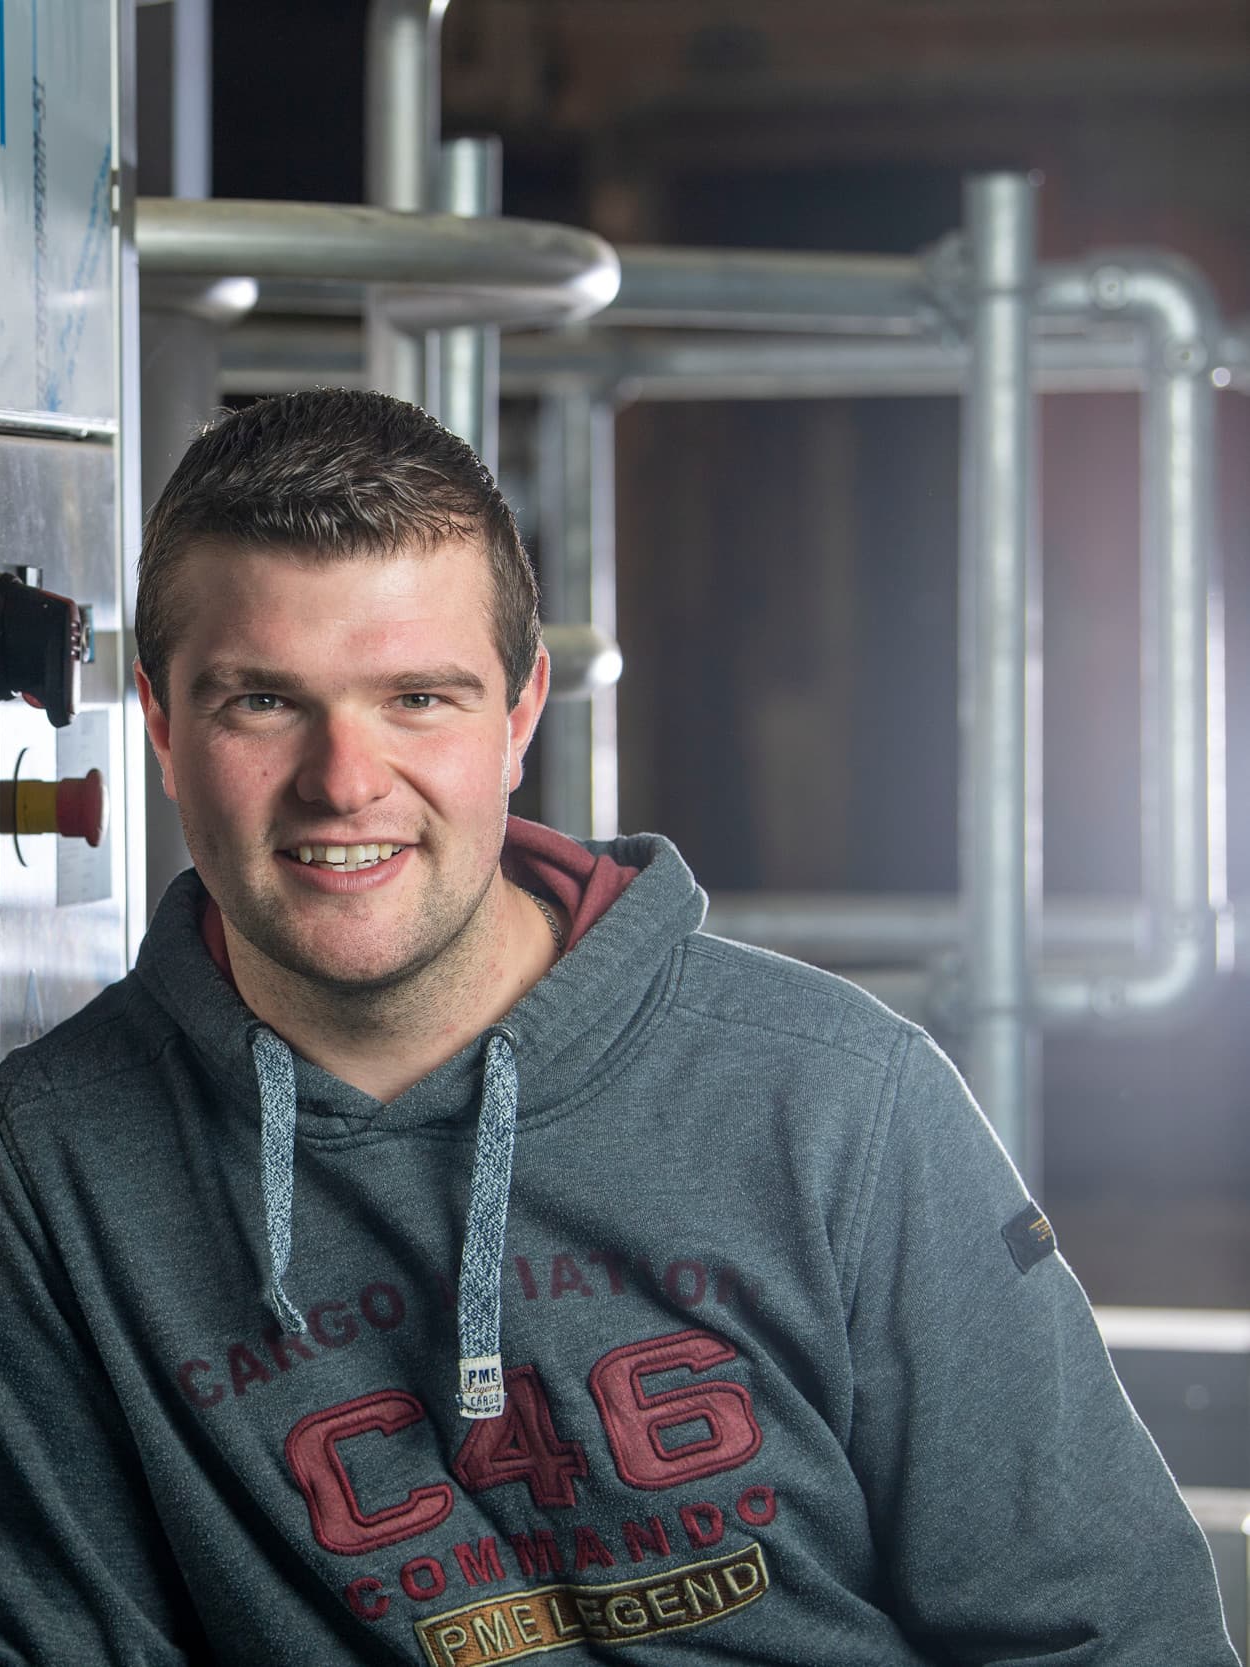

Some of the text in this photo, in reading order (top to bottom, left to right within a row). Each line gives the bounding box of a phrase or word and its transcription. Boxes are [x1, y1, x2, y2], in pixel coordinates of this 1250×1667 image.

[461, 1382, 502, 1396] Legend
[468, 1367, 498, 1385] PME
[346, 1485, 777, 1621] COMMANDO
[432, 1561, 760, 1667] PME LEGEND
